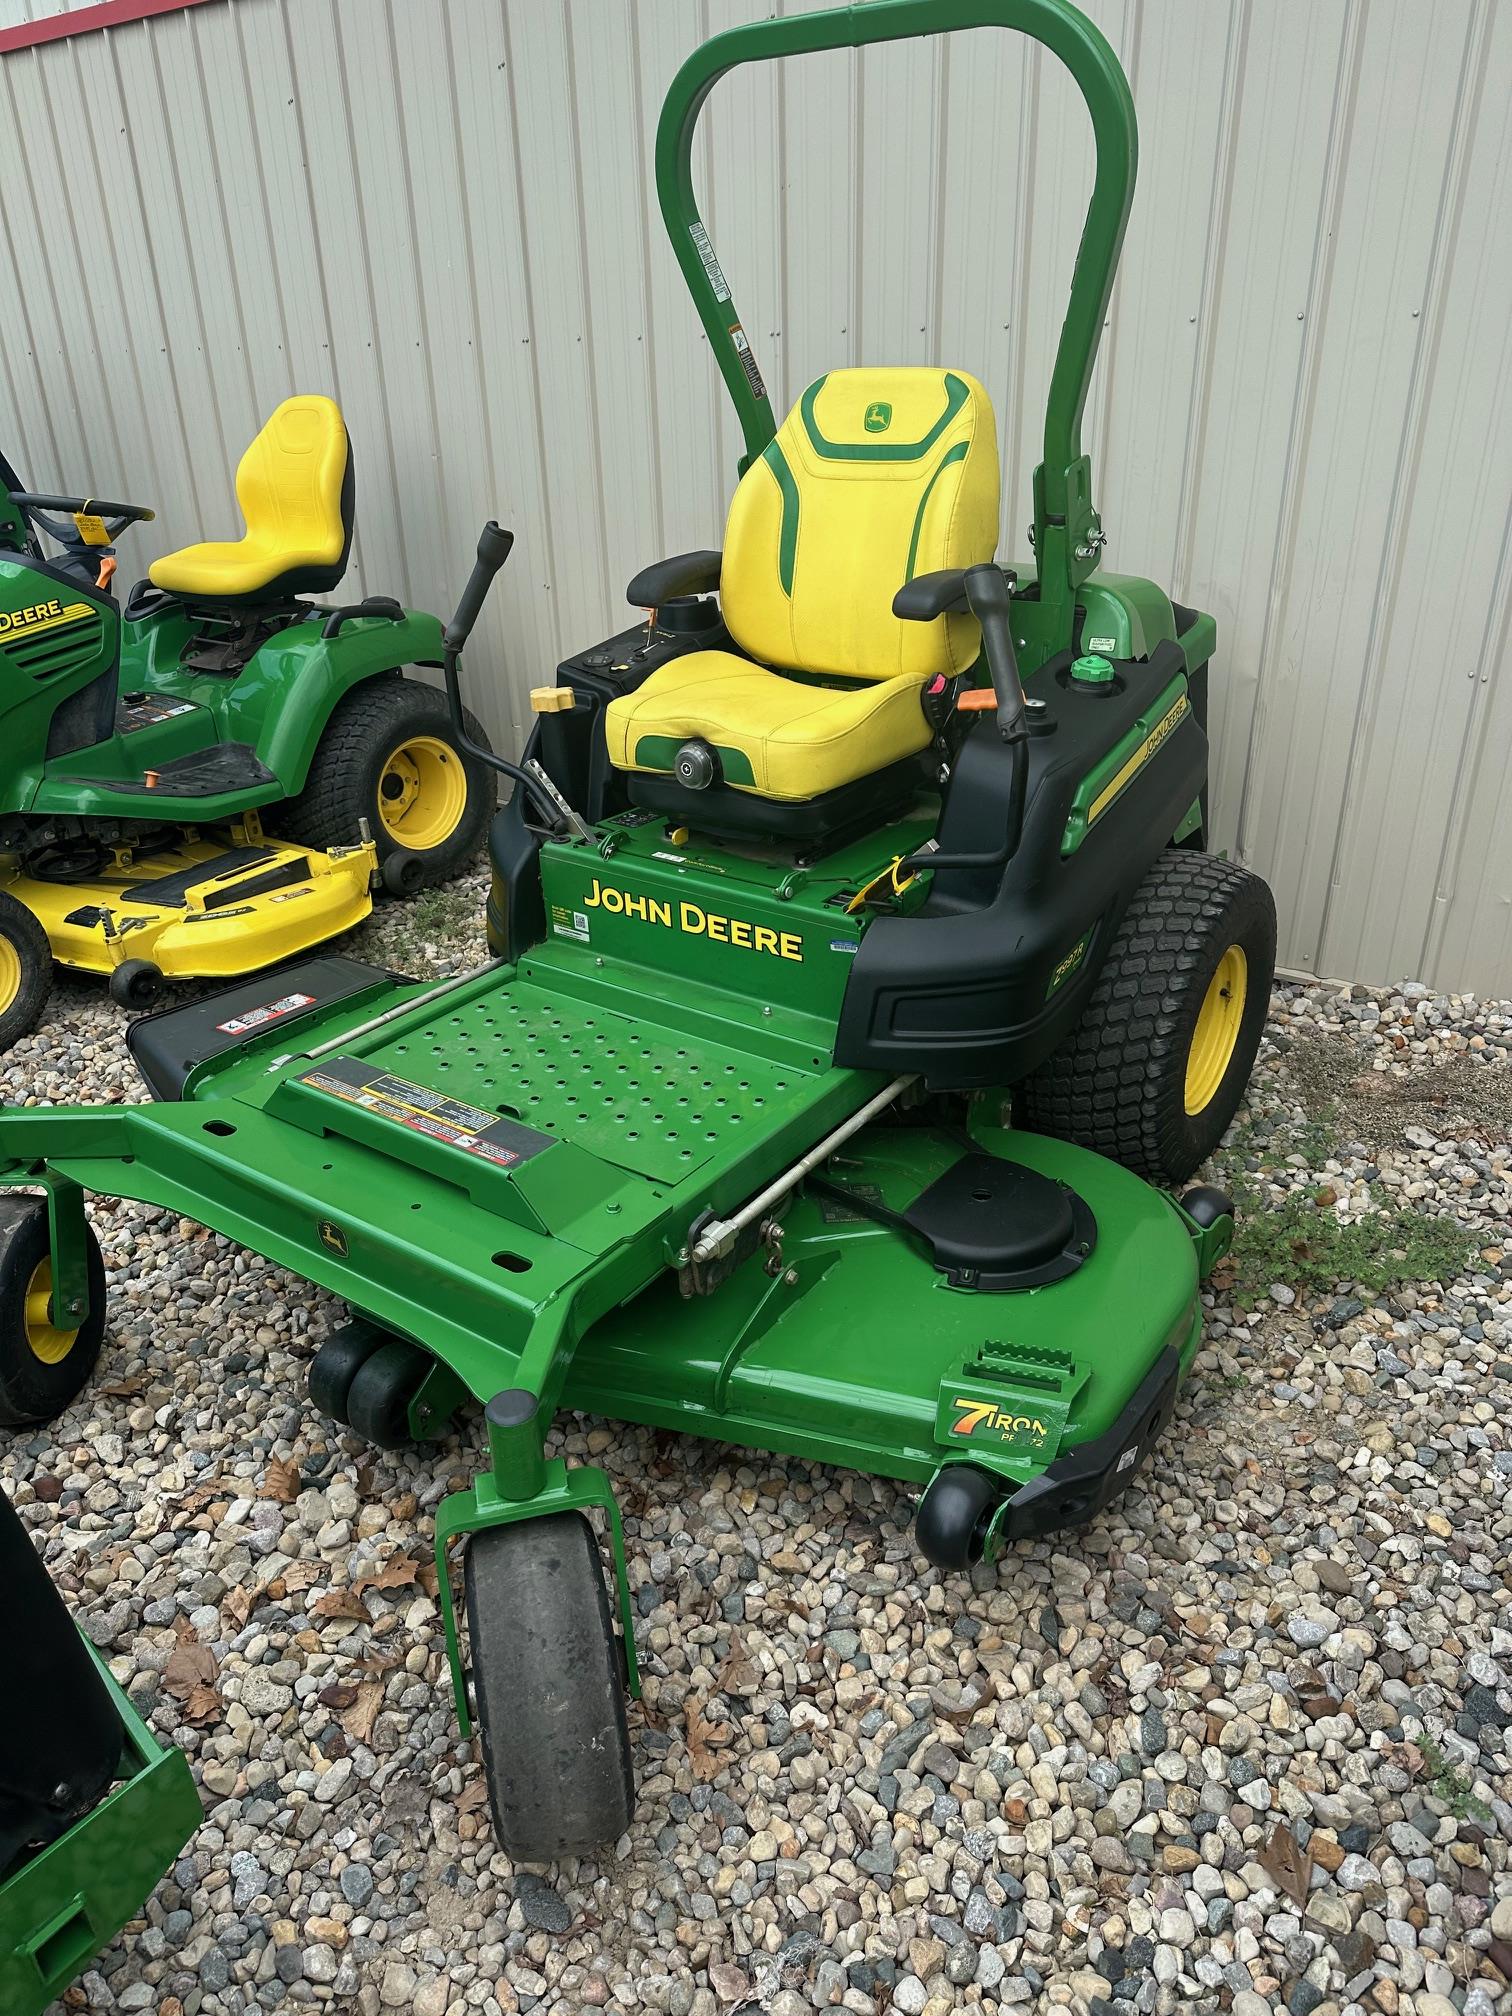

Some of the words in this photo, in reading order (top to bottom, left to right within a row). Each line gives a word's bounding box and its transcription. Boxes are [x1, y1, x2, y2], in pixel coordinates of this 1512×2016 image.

[0, 599, 62, 632] DEERE
[1144, 726, 1164, 760] JOHN
[1163, 700, 1184, 736] DEERE
[584, 878, 673, 928] JOHN
[679, 900, 804, 962] DEERE
